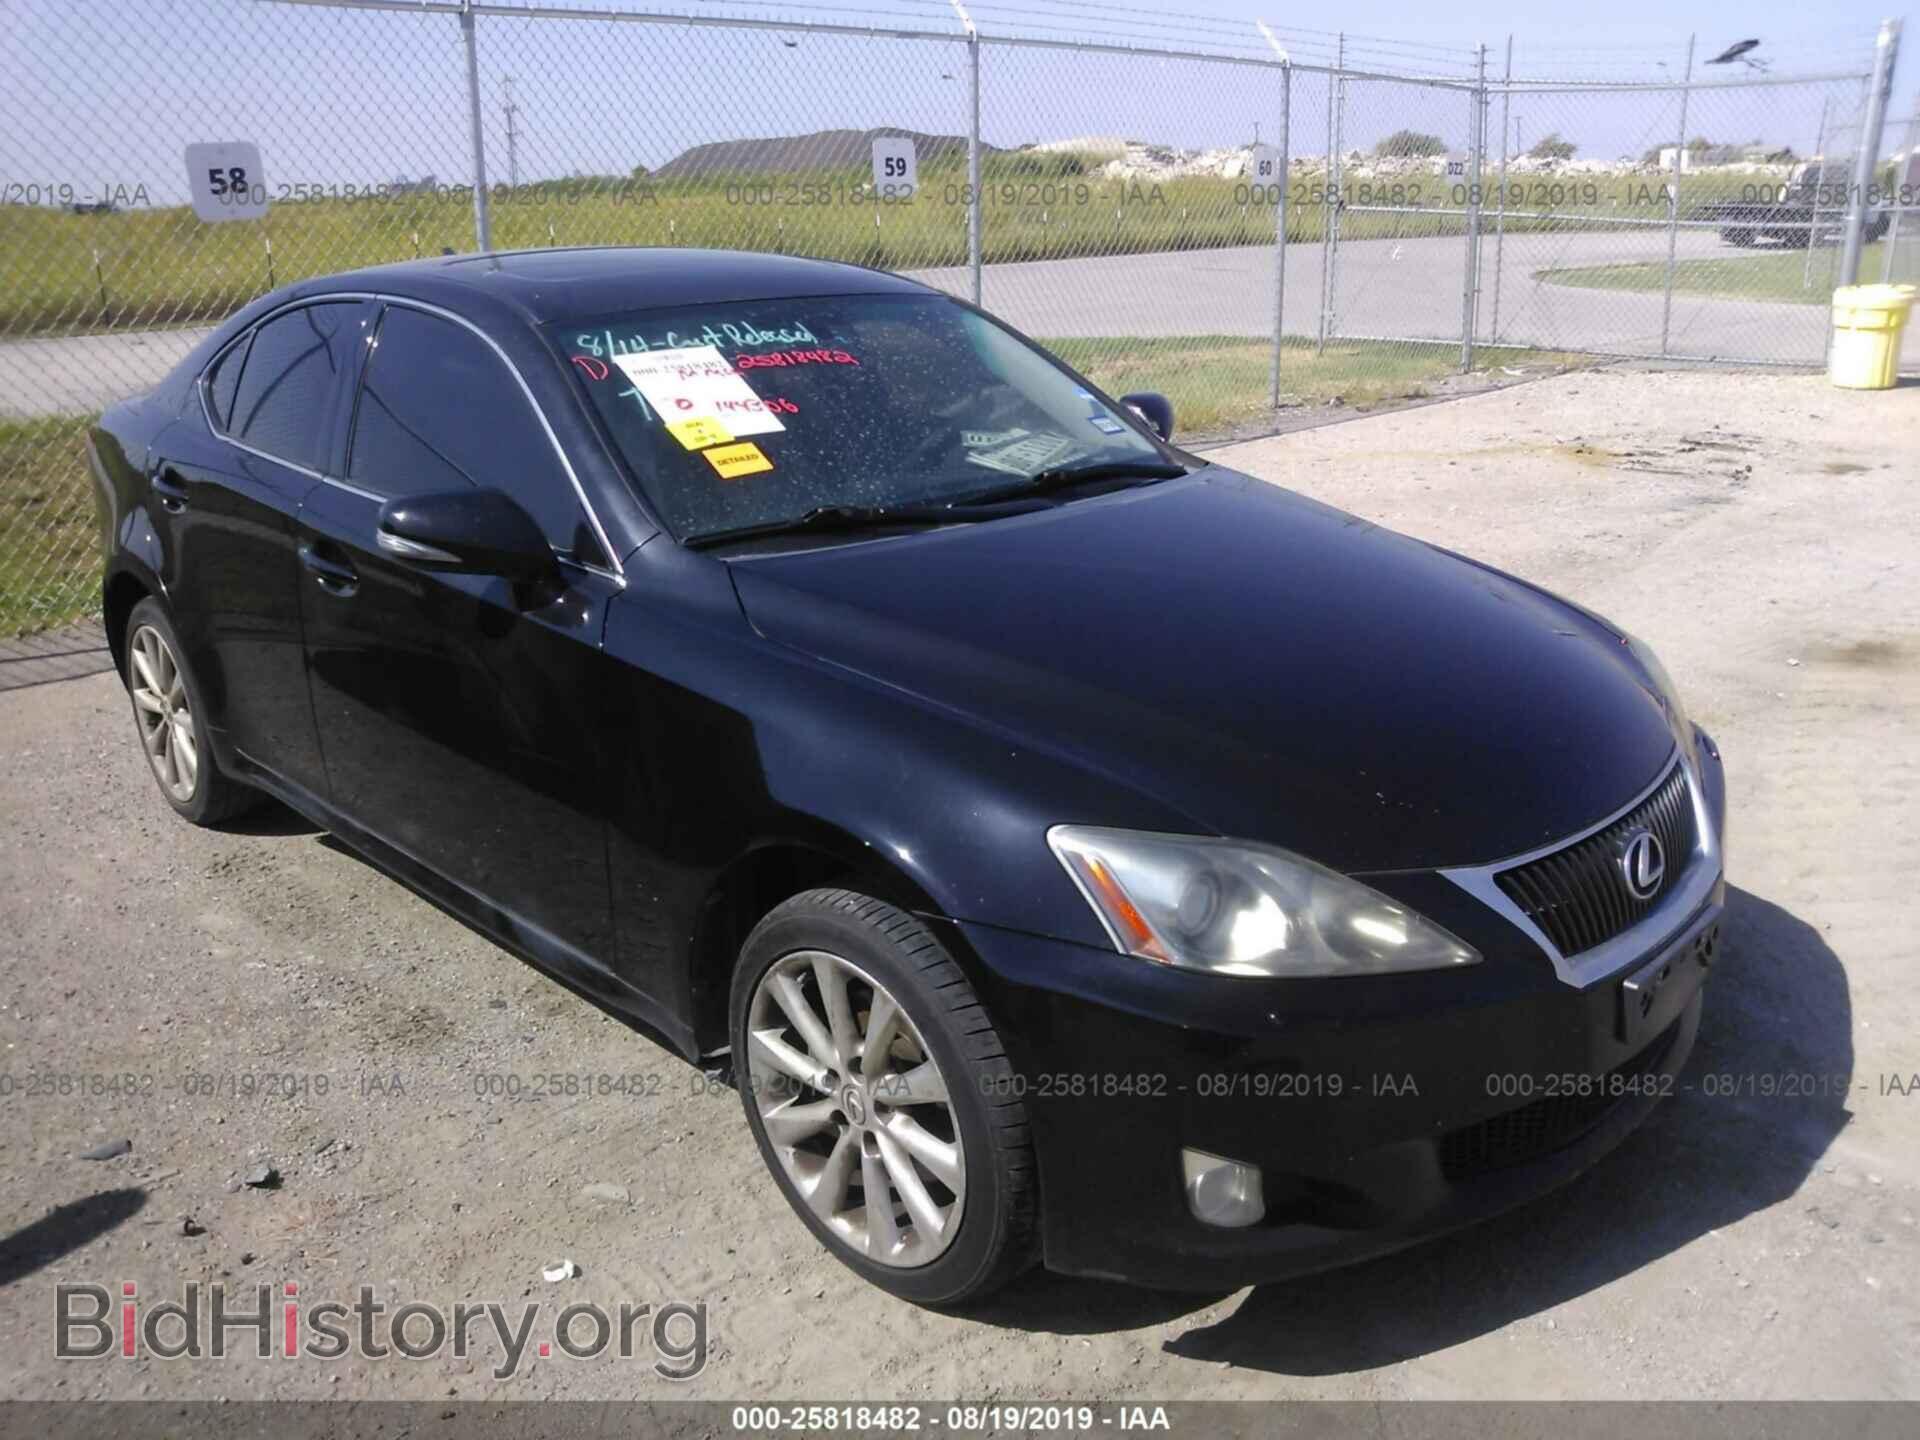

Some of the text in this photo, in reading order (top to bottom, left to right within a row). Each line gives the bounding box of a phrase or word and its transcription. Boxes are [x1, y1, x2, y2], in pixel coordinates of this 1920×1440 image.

[885, 157, 906, 177] 59
[1259, 160, 1272, 176] 60
[209, 168, 249, 195] 58
